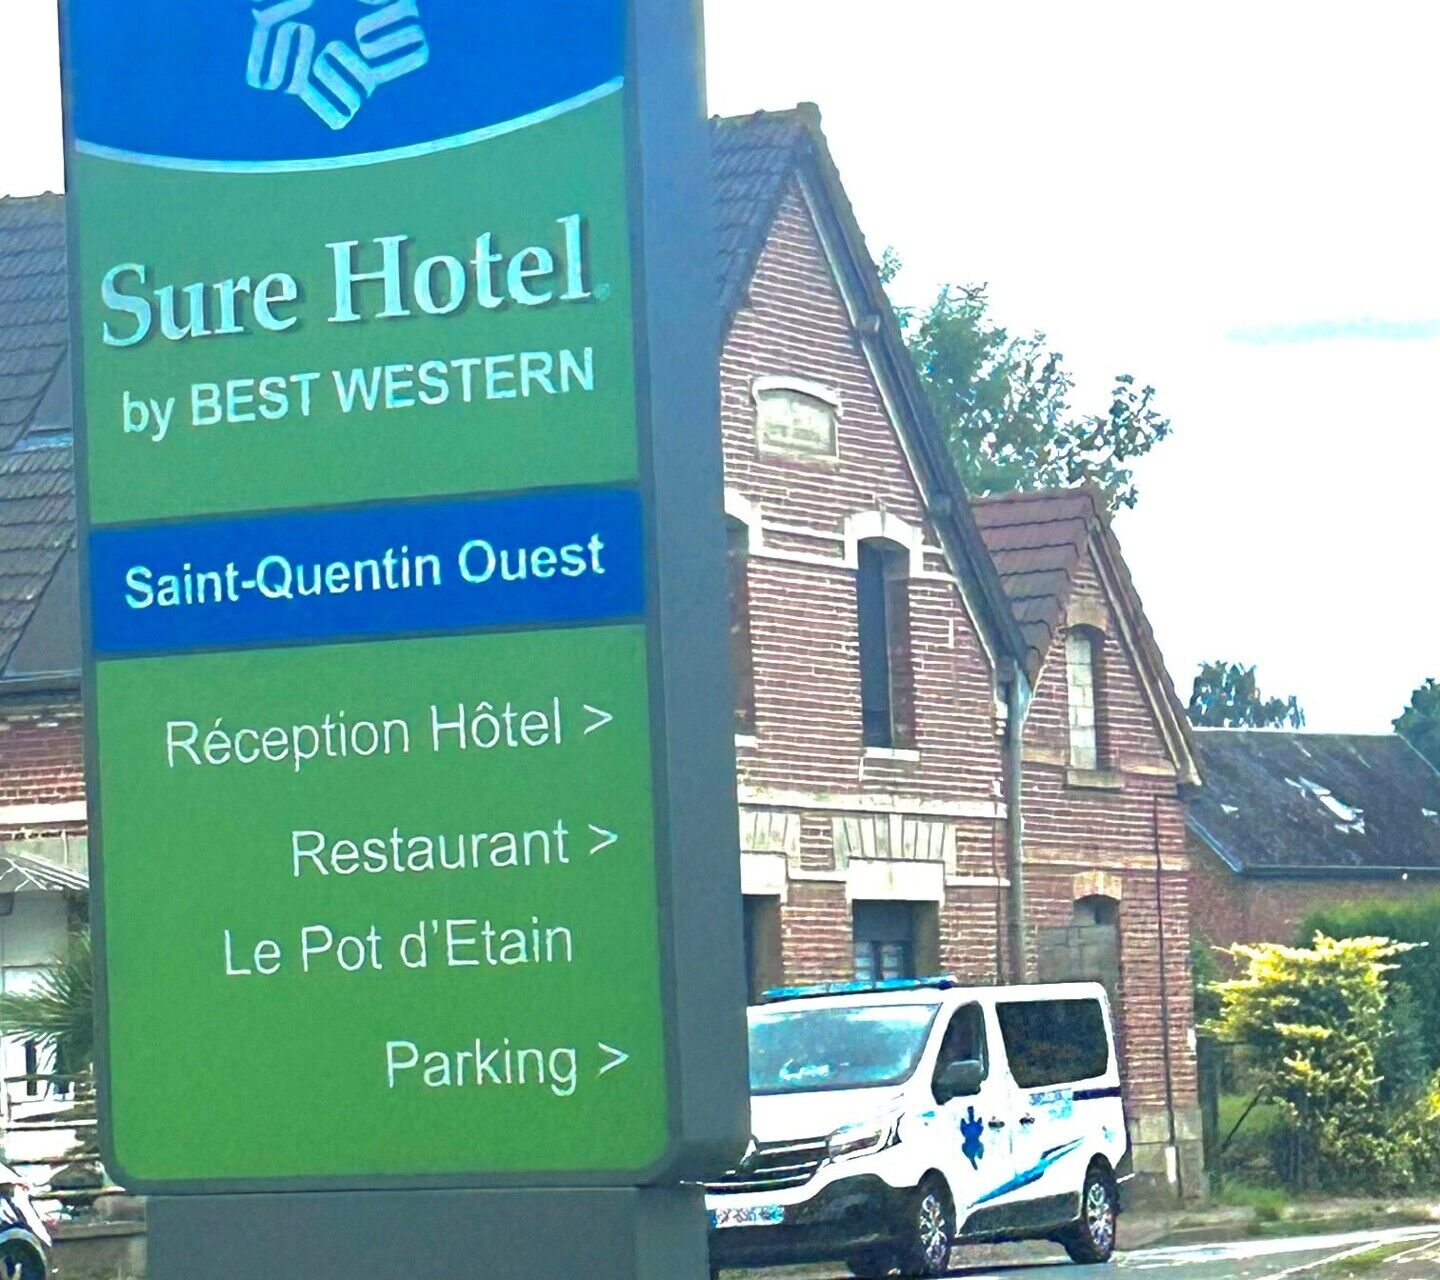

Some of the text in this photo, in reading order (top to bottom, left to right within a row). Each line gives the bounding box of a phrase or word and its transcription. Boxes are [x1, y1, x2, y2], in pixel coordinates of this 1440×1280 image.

[101, 213, 592, 347] Sure Hotel
[122, 347, 595, 442] by BEST WESTERN
[125, 533, 606, 610] Saint-Quentin Ouest
[166, 696, 562, 773] Réception Hôtel
[291, 819, 570, 877] Restaurant
[224, 916, 573, 976] Le Pot d'Etain
[385, 1037, 578, 1097] Parking
